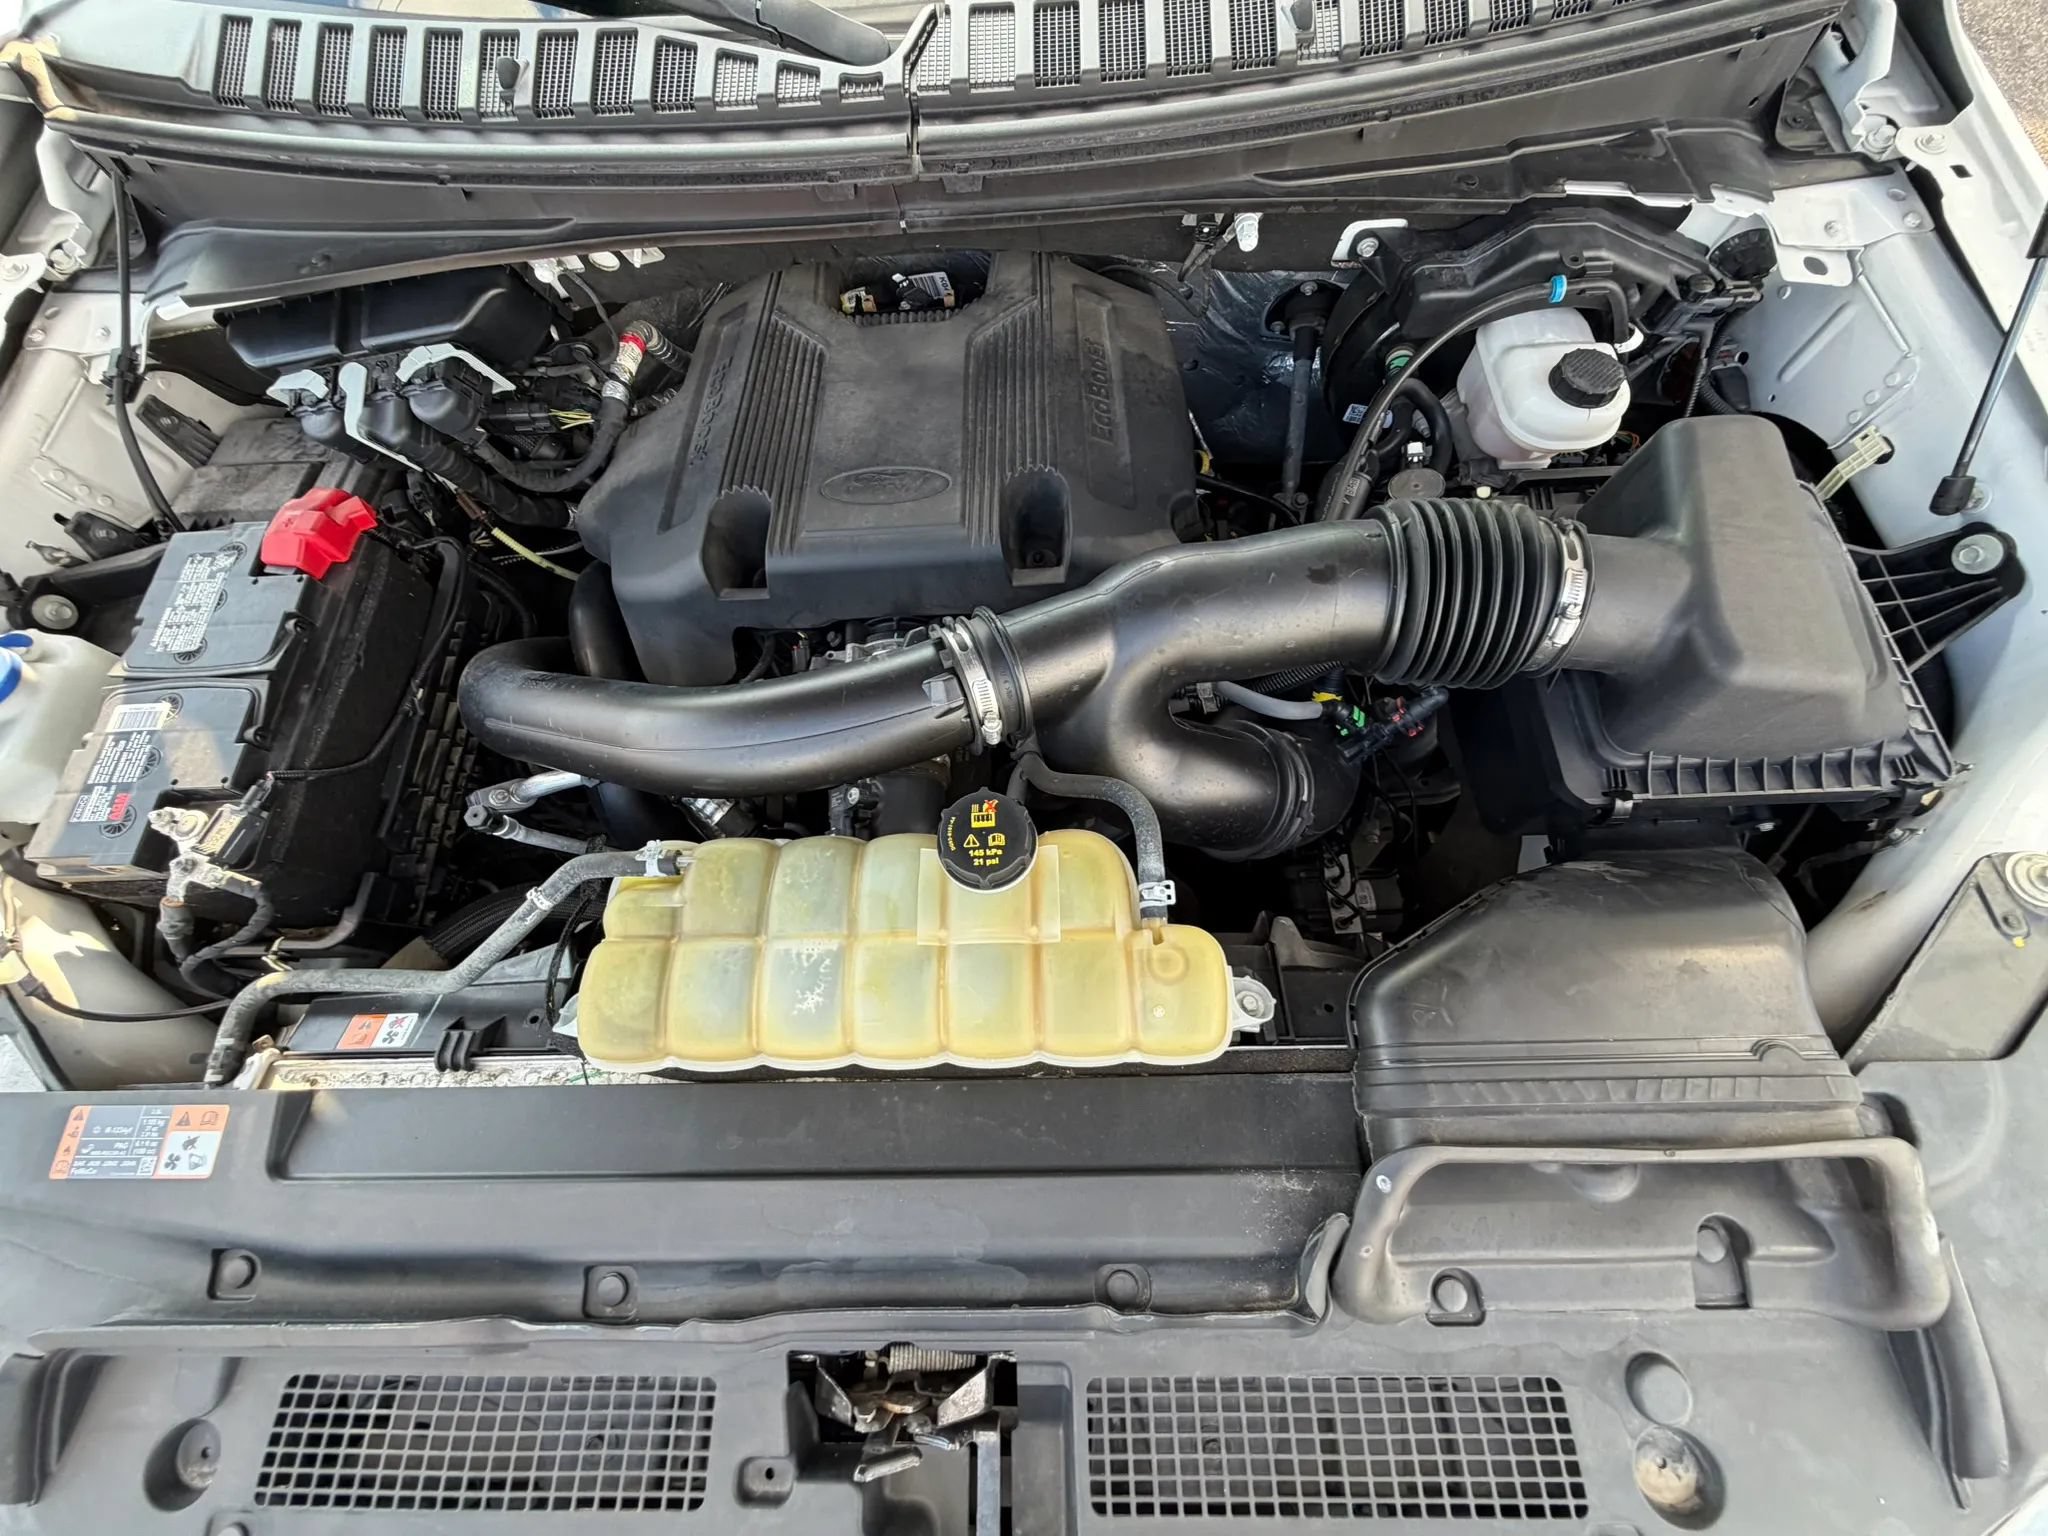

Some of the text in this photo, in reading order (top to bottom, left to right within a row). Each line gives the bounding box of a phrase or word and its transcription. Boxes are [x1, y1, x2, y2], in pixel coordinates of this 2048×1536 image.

[1085, 343, 1114, 446] EcoBoost
[986, 848, 1003, 856] kPa
[973, 857, 999, 866] 21 psi
